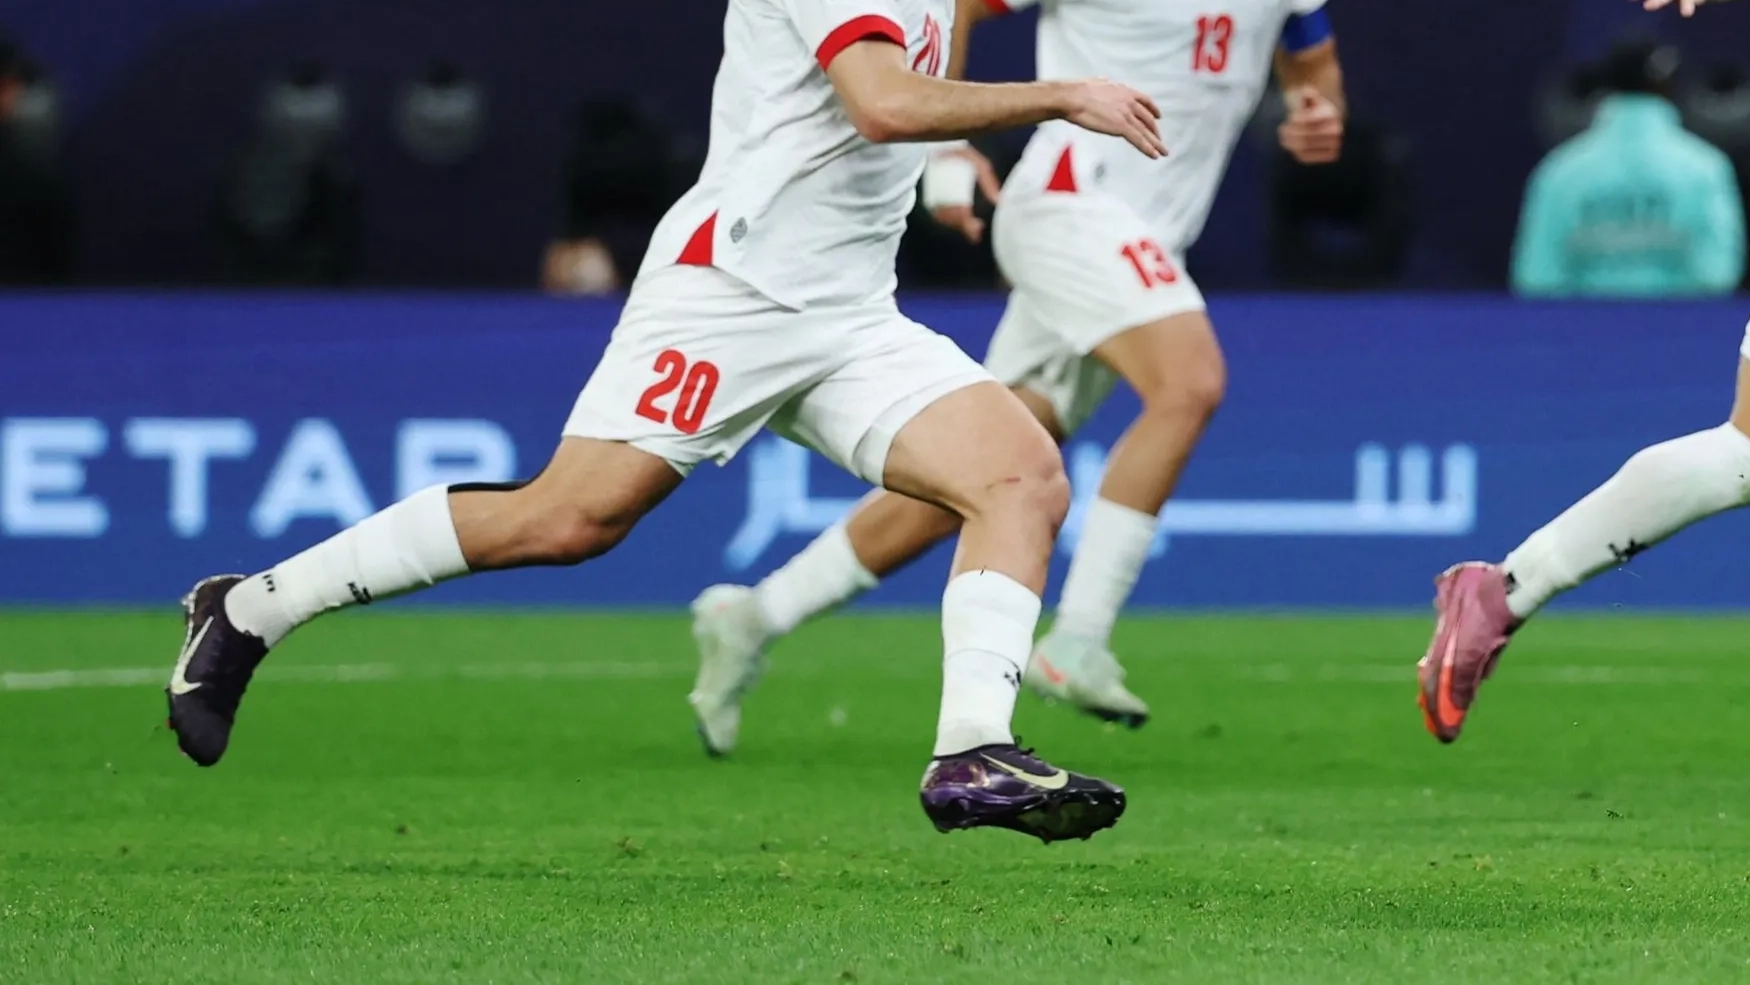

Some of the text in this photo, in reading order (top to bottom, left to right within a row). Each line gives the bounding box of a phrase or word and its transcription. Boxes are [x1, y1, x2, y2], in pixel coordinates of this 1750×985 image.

[1192, 13, 1232, 73] 13
[1121, 239, 1177, 288] 13
[635, 349, 720, 435] 20
